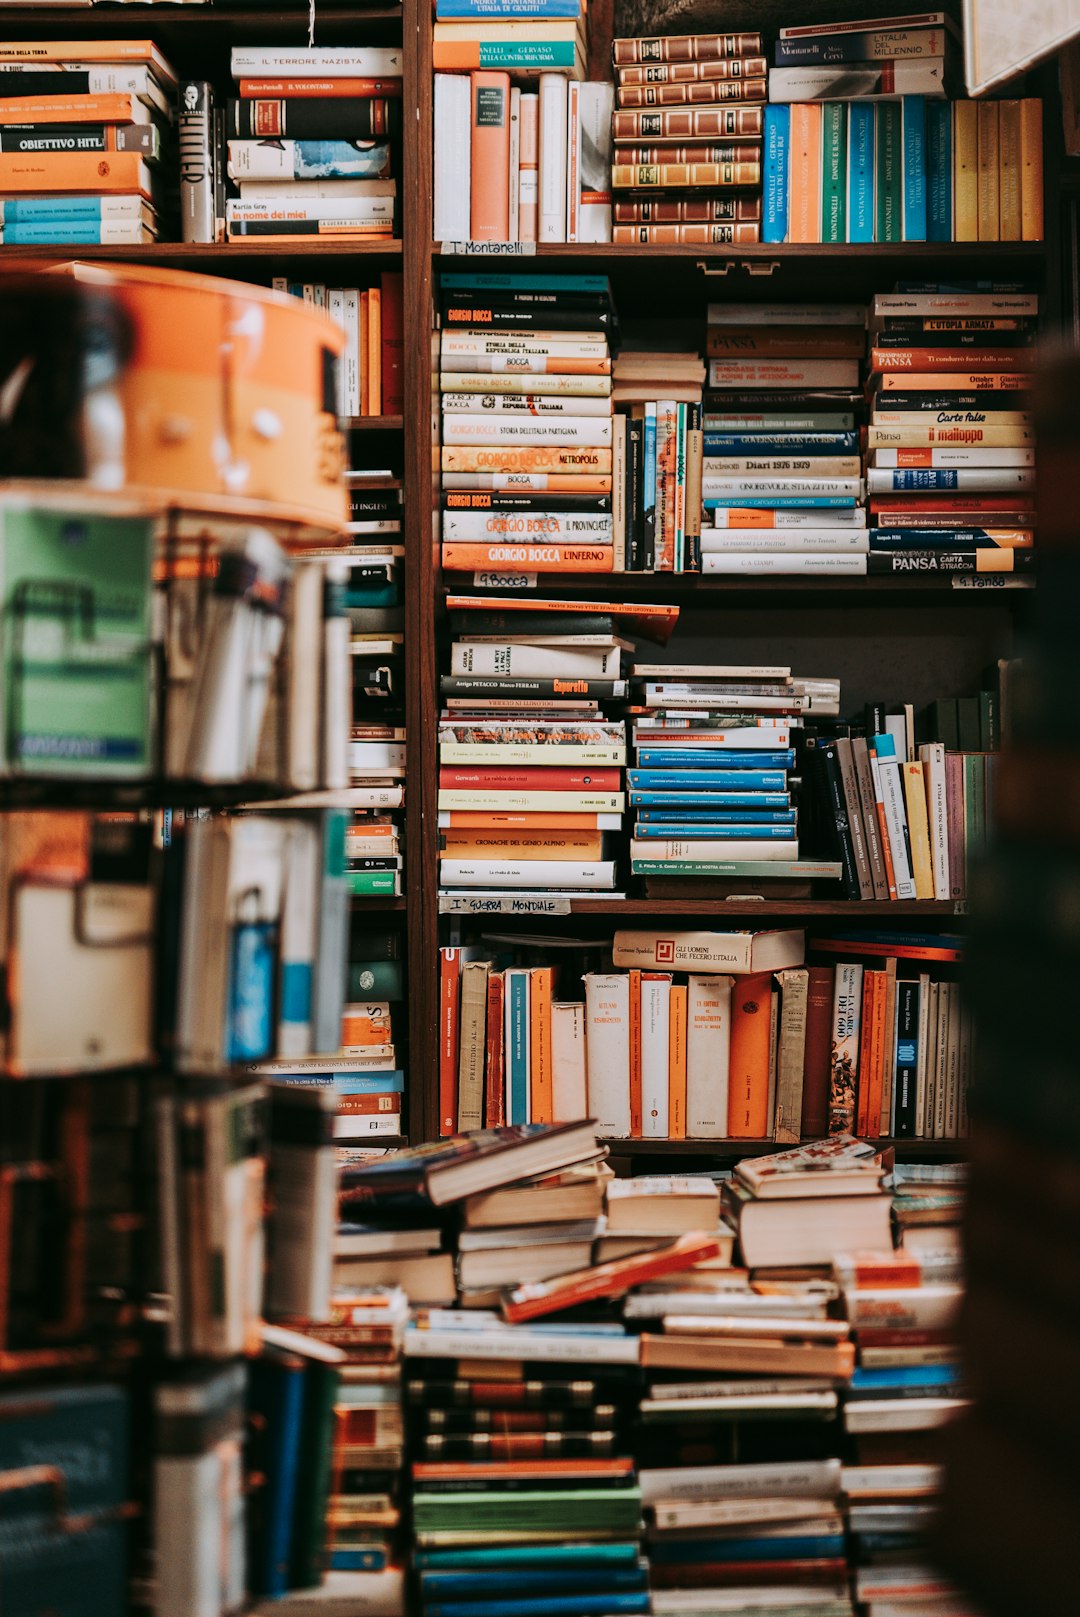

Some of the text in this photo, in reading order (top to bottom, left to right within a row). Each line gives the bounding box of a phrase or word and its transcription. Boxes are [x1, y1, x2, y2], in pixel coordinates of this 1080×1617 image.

[874, 33, 909, 42] L'ITALIA
[874, 46, 923, 56] MILLENNIO
[19, 138, 76, 150] OBIETTIVO
[180, 115, 205, 184] HITLER
[768, 124, 777, 223] MONTANELLI GERVASO
[832, 159, 840, 180] DANTE
[232, 212, 242, 220] In
[275, 211, 285, 219] dei
[287, 210, 307, 219] miei
[831, 195, 839, 241] MONTANELLI
[885, 196, 893, 241] MONTANELLI
[465, 240, 524, 255] Montanelli
[447, 309, 493, 322] GIORGIO BOCCA
[930, 320, 996, 330] L'UTOPIA ARMATA
[712, 338, 759, 350] PANSA
[506, 357, 530, 366] BOCCA
[878, 358, 913, 367] PANSA
[490, 379, 513, 387] BOCCA
[969, 375, 994, 384] Ottobre
[446, 400, 470, 408] BOCCA
[937, 411, 987, 424] Carte false
[499, 427, 519, 435] STORIA
[548, 428, 578, 436] PARTIGIANA
[876, 427, 984, 445] Pansa malloppo
[476, 451, 518, 467] GIORGIO
[558, 454, 599, 465] METROPOLIS
[745, 461, 811, 470] Diari 1976 1979
[507, 475, 531, 483] BOCCA
[359, 503, 388, 511] INGLESI
[447, 495, 492, 507] GIORGIO BOCCA
[486, 519, 525, 533] GIORGIO
[527, 519, 561, 533] BOCCA
[571, 520, 609, 532] PROVINCIALE
[488, 547, 605, 562] GIORGIO BOCCA L'INFERNO
[892, 555, 964, 571] PANSA CARTA
[940, 562, 975, 570] STRACCIA
[472, 680, 499, 688] PETACCO
[515, 682, 540, 690] FERRARI
[469, 899, 502, 911] GUERRA
[511, 899, 556, 912] MONDIALE
[688, 945, 710, 953] UOMINI
[713, 954, 738, 962] L'ITALIA
[837, 995, 848, 1039] DEI 600
[846, 994, 856, 1038] LA CARICA
[469, 1031, 477, 1082] PRELUDIO AL
[898, 1044, 915, 1062] 100
